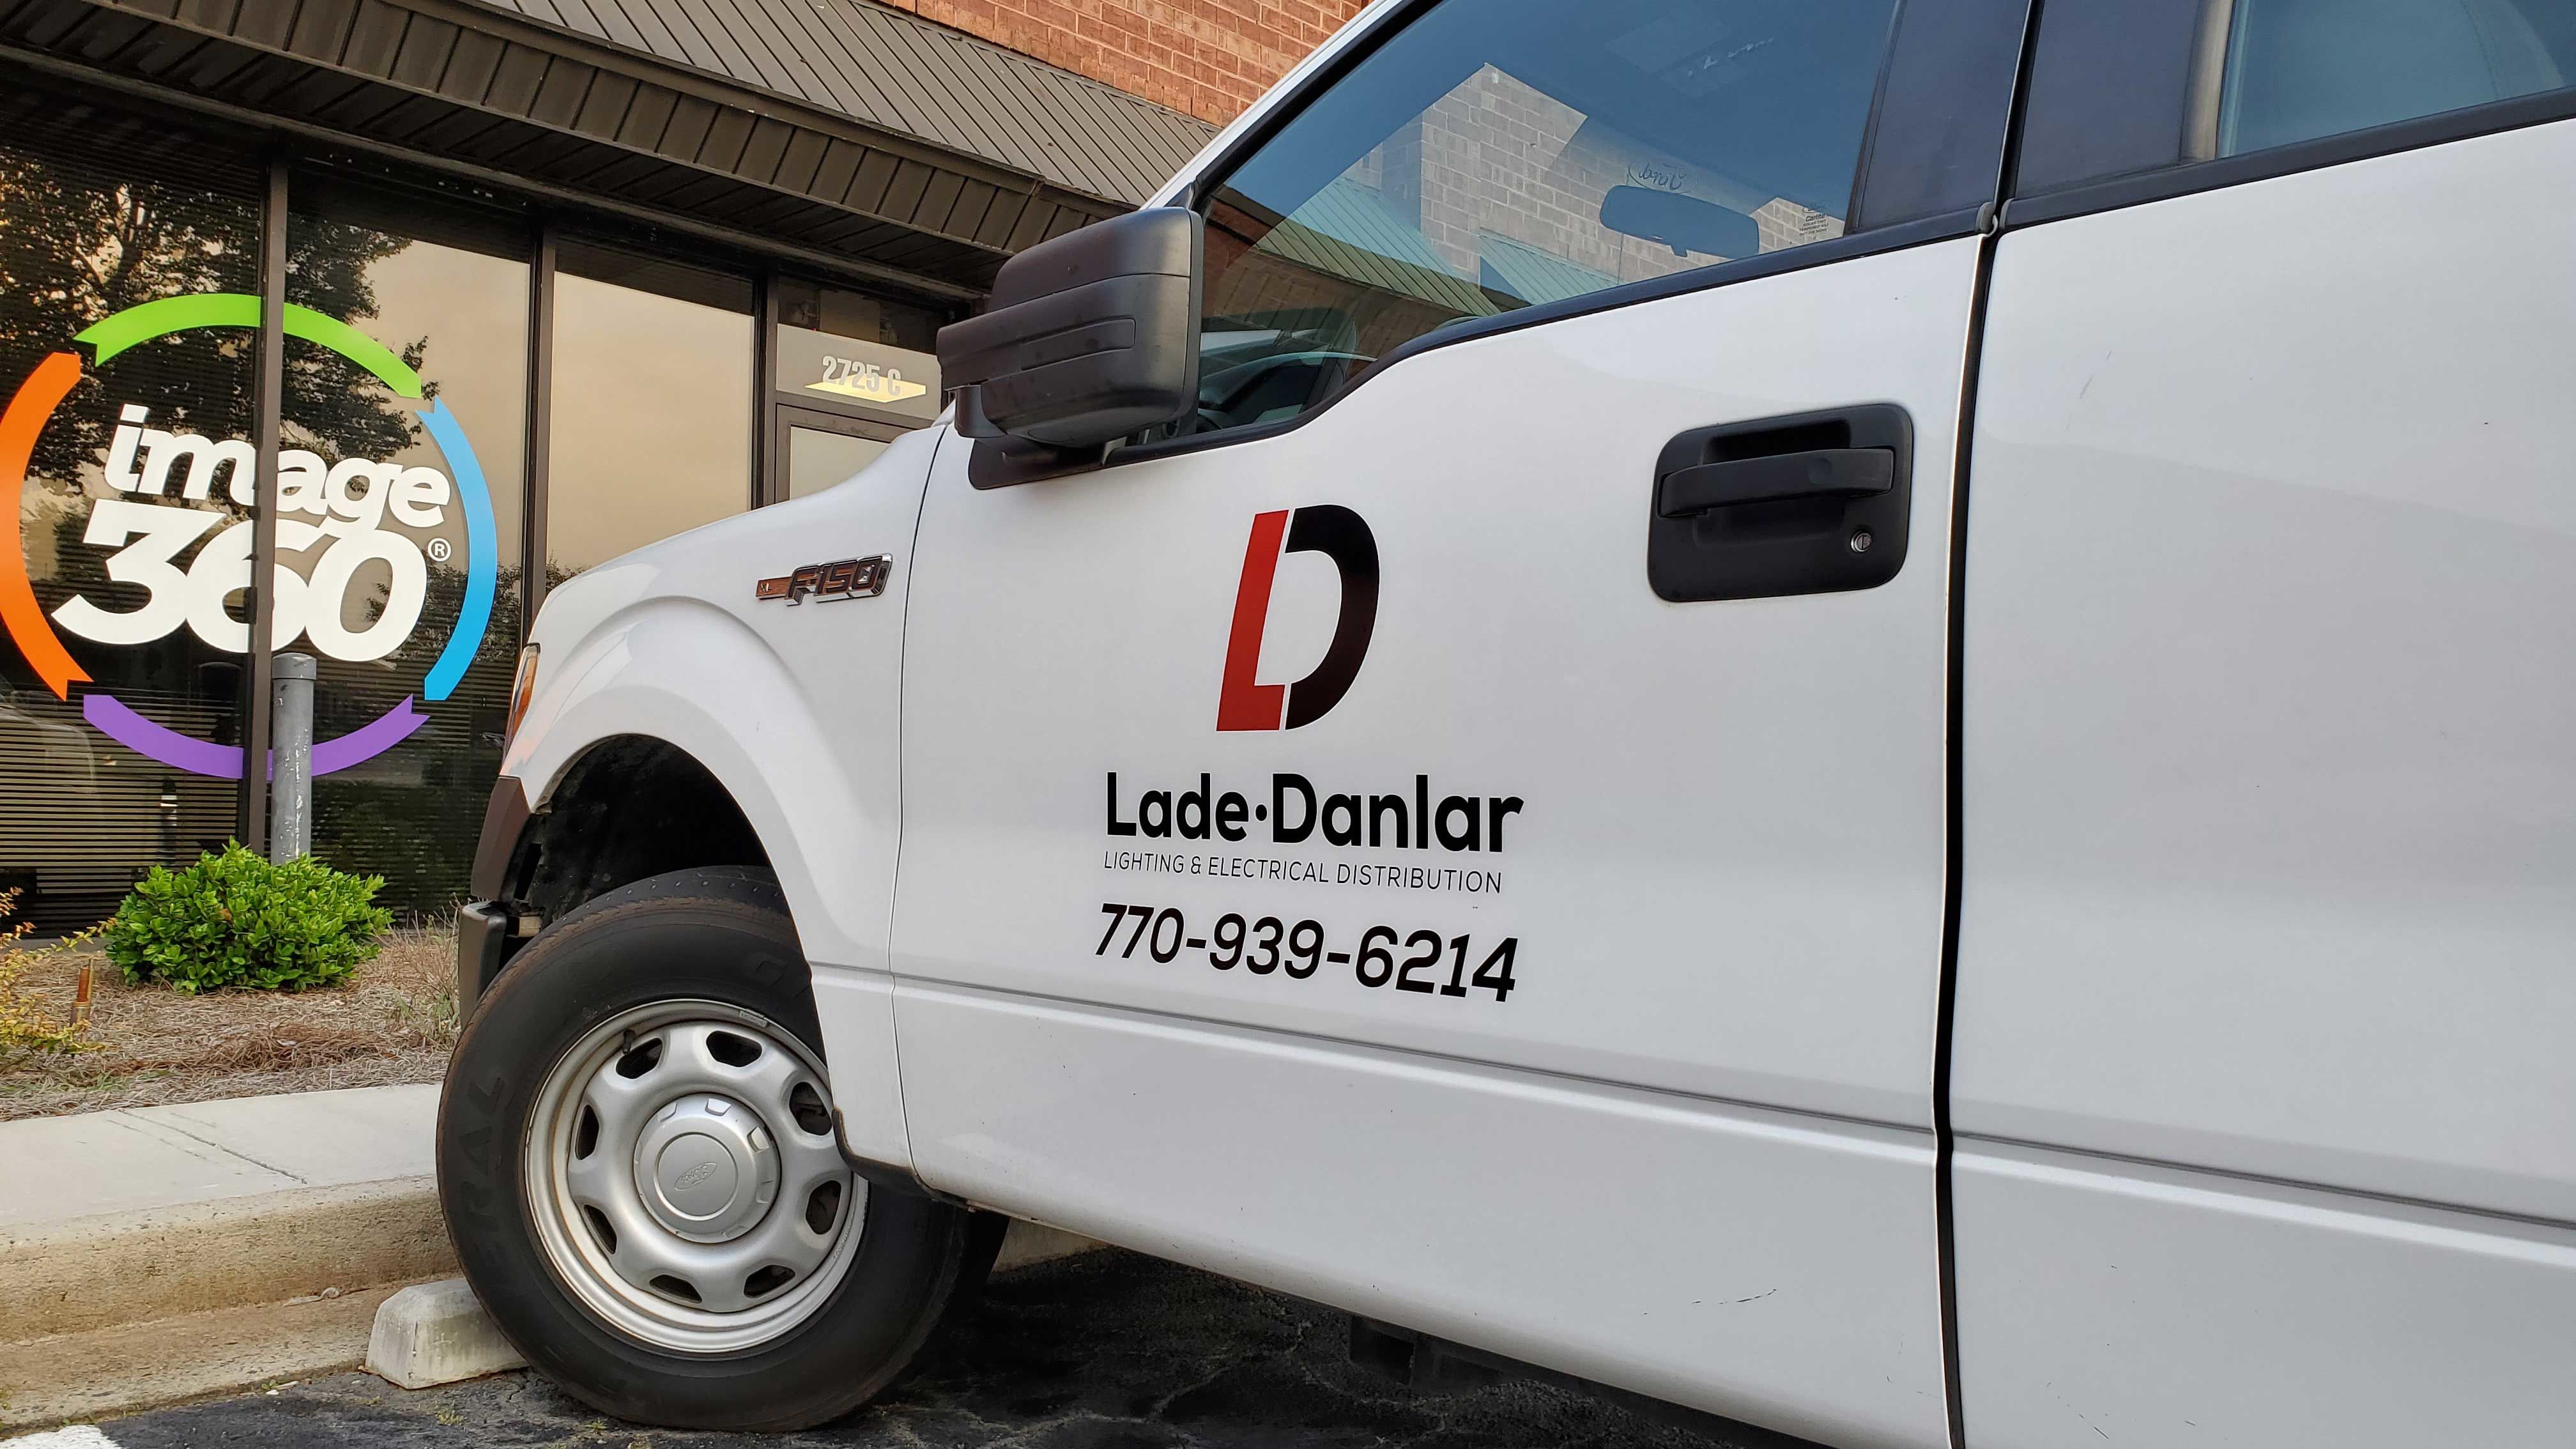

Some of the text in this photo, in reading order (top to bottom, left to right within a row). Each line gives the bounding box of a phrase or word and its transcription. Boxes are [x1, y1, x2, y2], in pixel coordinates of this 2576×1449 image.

[822, 355, 901, 396] 2725 C
[104, 404, 451, 530] image
[51, 498, 427, 662] 360
[1104, 850, 1501, 894] LIGHTING & ELECTRICAL DISTRIBUTION
[1096, 903, 1519, 1002] 770-939-6214
